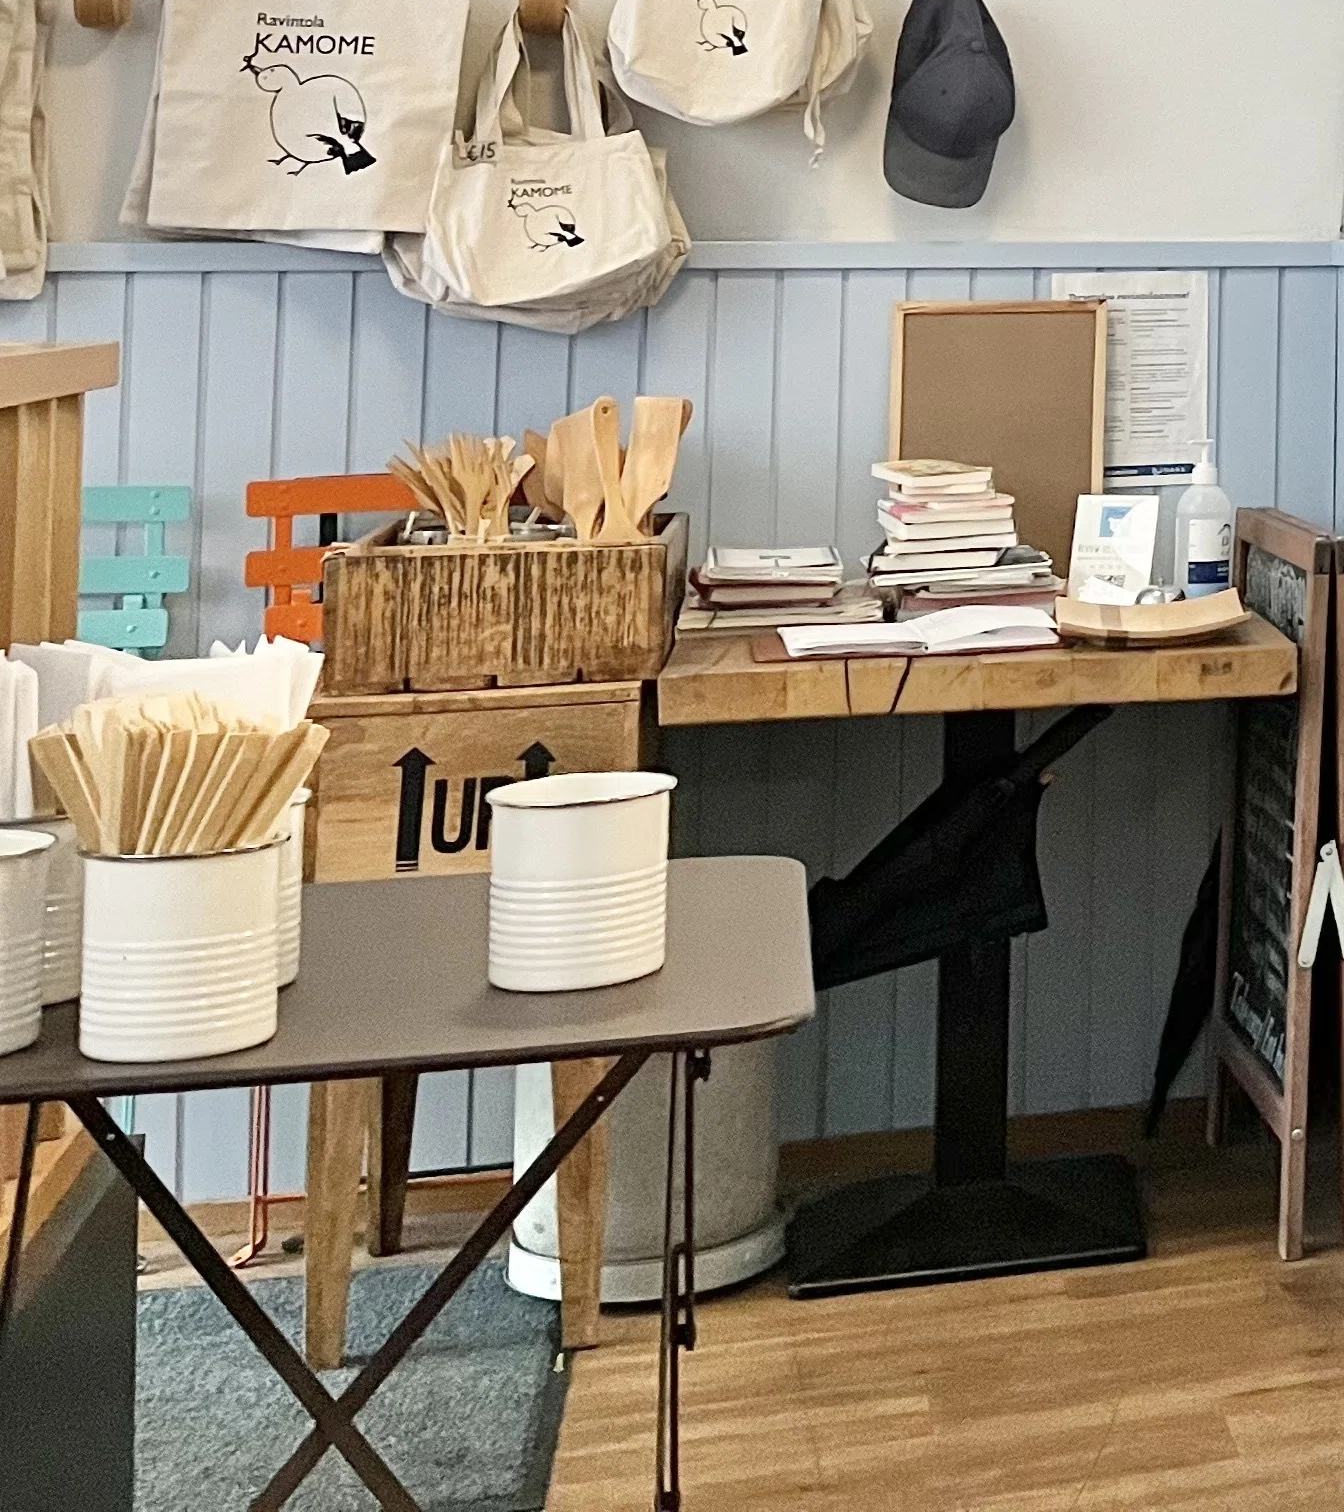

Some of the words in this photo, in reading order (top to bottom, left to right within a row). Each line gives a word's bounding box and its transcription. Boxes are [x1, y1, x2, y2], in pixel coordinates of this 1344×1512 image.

[257, 12, 325, 28] Ravintola
[255, 32, 376, 55] KAMOME
[467, 141, 496, 162] €15
[510, 184, 573, 199] KAMOME
